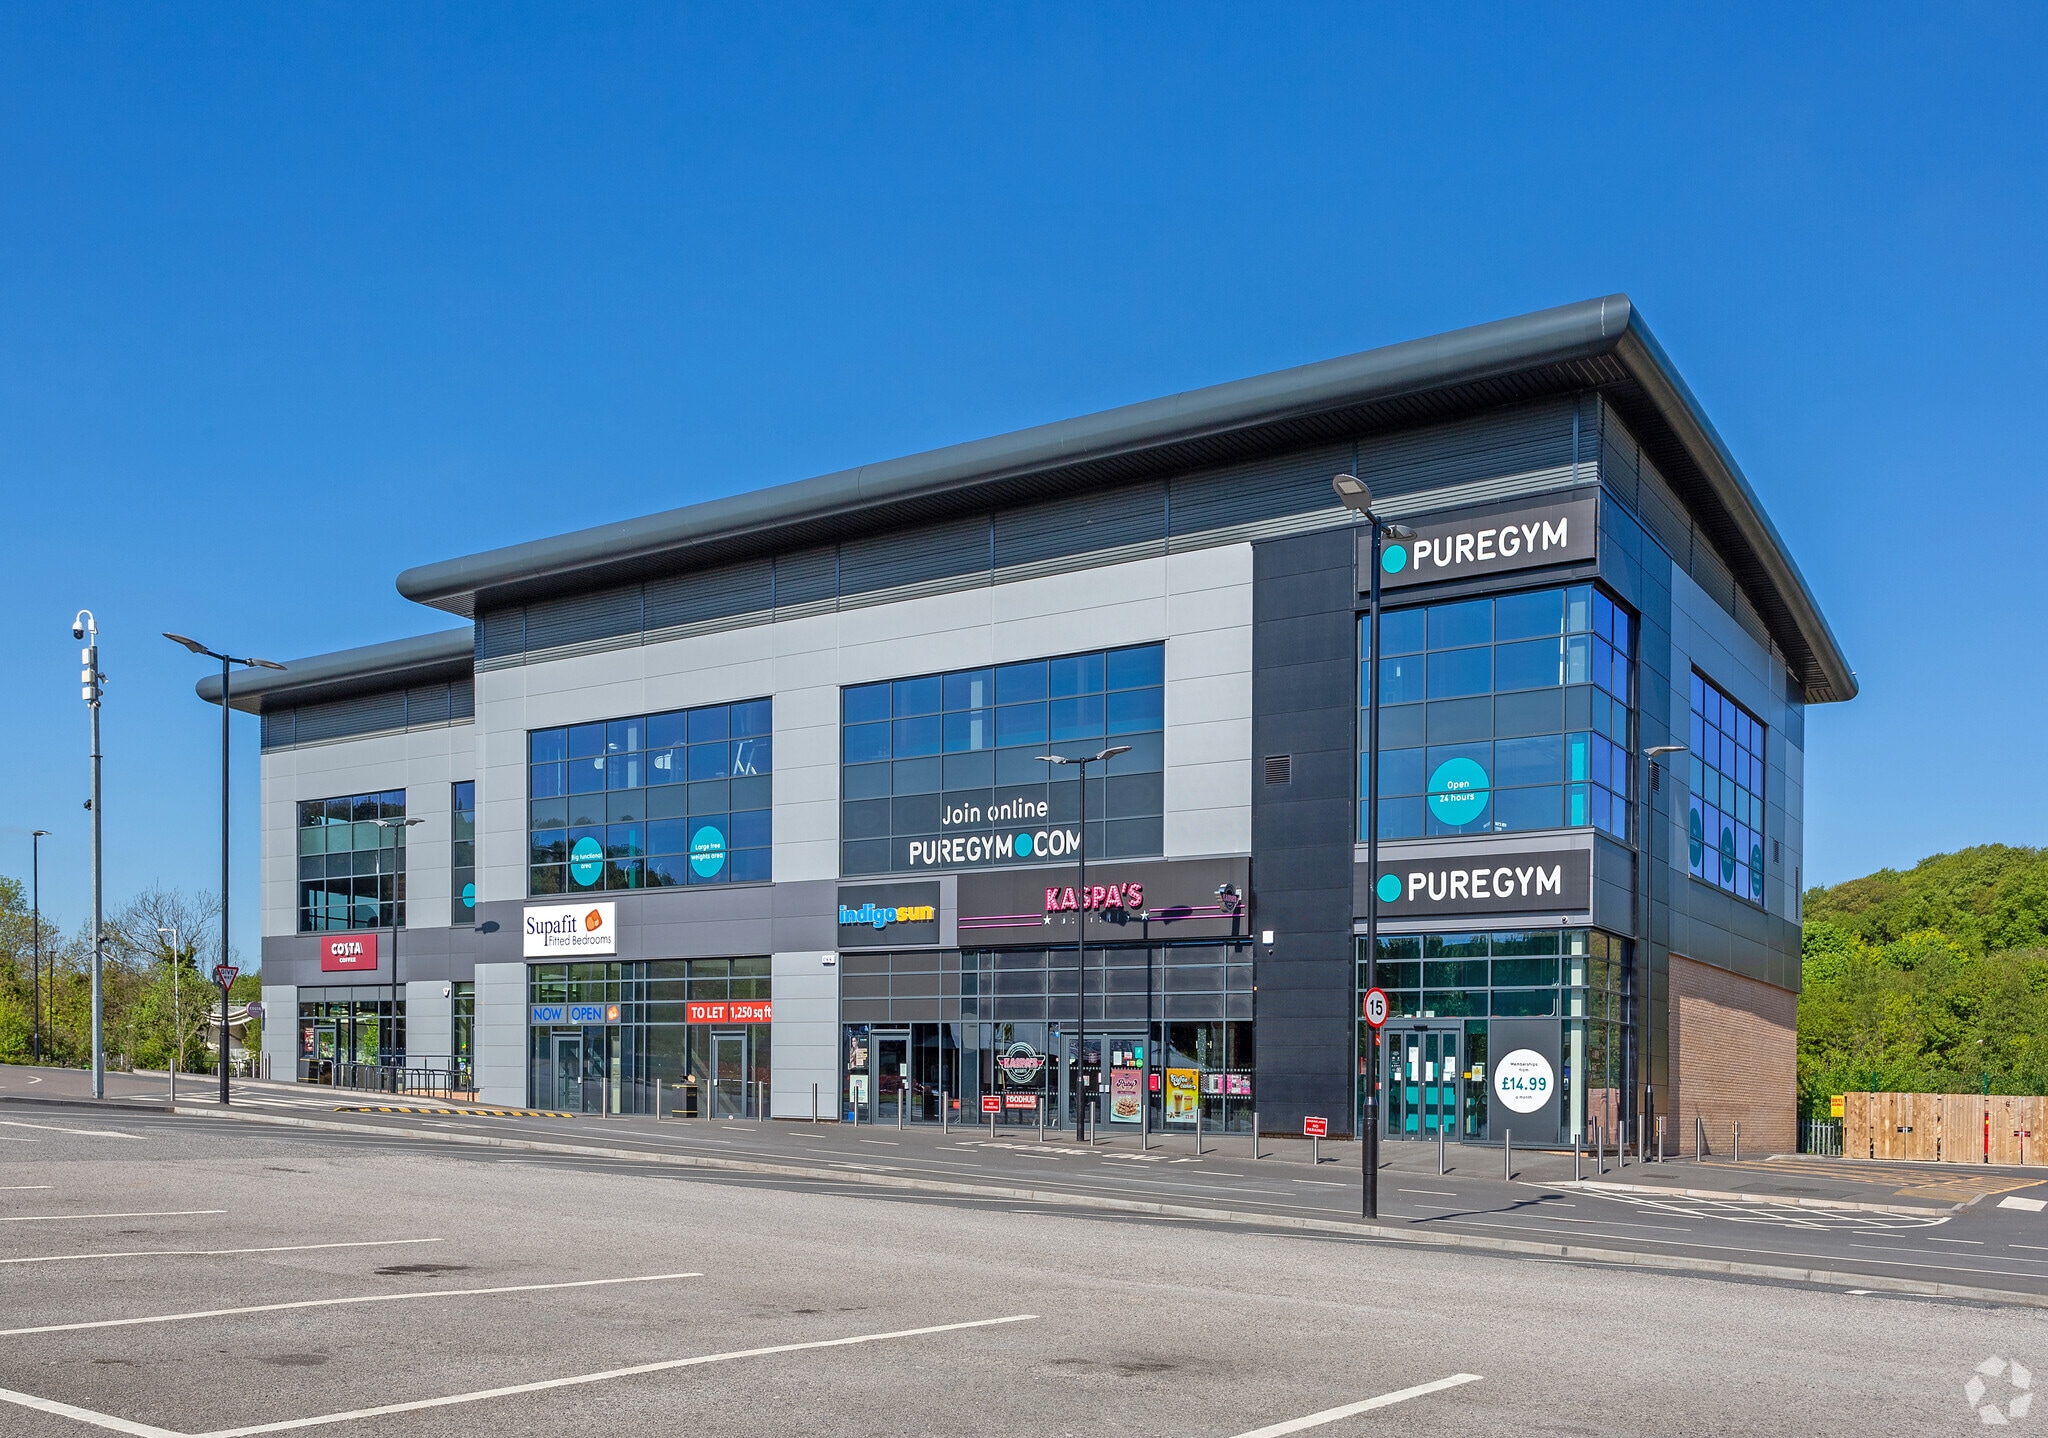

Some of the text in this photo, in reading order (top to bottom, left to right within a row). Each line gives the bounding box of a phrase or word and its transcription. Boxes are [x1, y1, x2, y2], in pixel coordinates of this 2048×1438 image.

[1413, 517, 1568, 571] PUREGYM
[1447, 781, 1470, 790] Open
[1440, 793, 1475, 802] 24 hours
[942, 797, 1048, 825] Join online
[695, 844, 709, 852] Large
[1408, 864, 1562, 902] PUREGYM
[1045, 882, 1143, 911] KASPA'S
[838, 903, 935, 929] indigosun
[526, 914, 577, 947] Supafit
[549, 933, 612, 946] Fitted Bedrooms
[331, 942, 363, 956] COSTA
[533, 1007, 602, 1021] NOW OPEN
[691, 1005, 772, 1021] TO LET 1,250 sq ft
[1369, 999, 1383, 1016] 15
[1501, 1076, 1547, 1091] £14.99
[1006, 1095, 1036, 1103] FOODHUB
